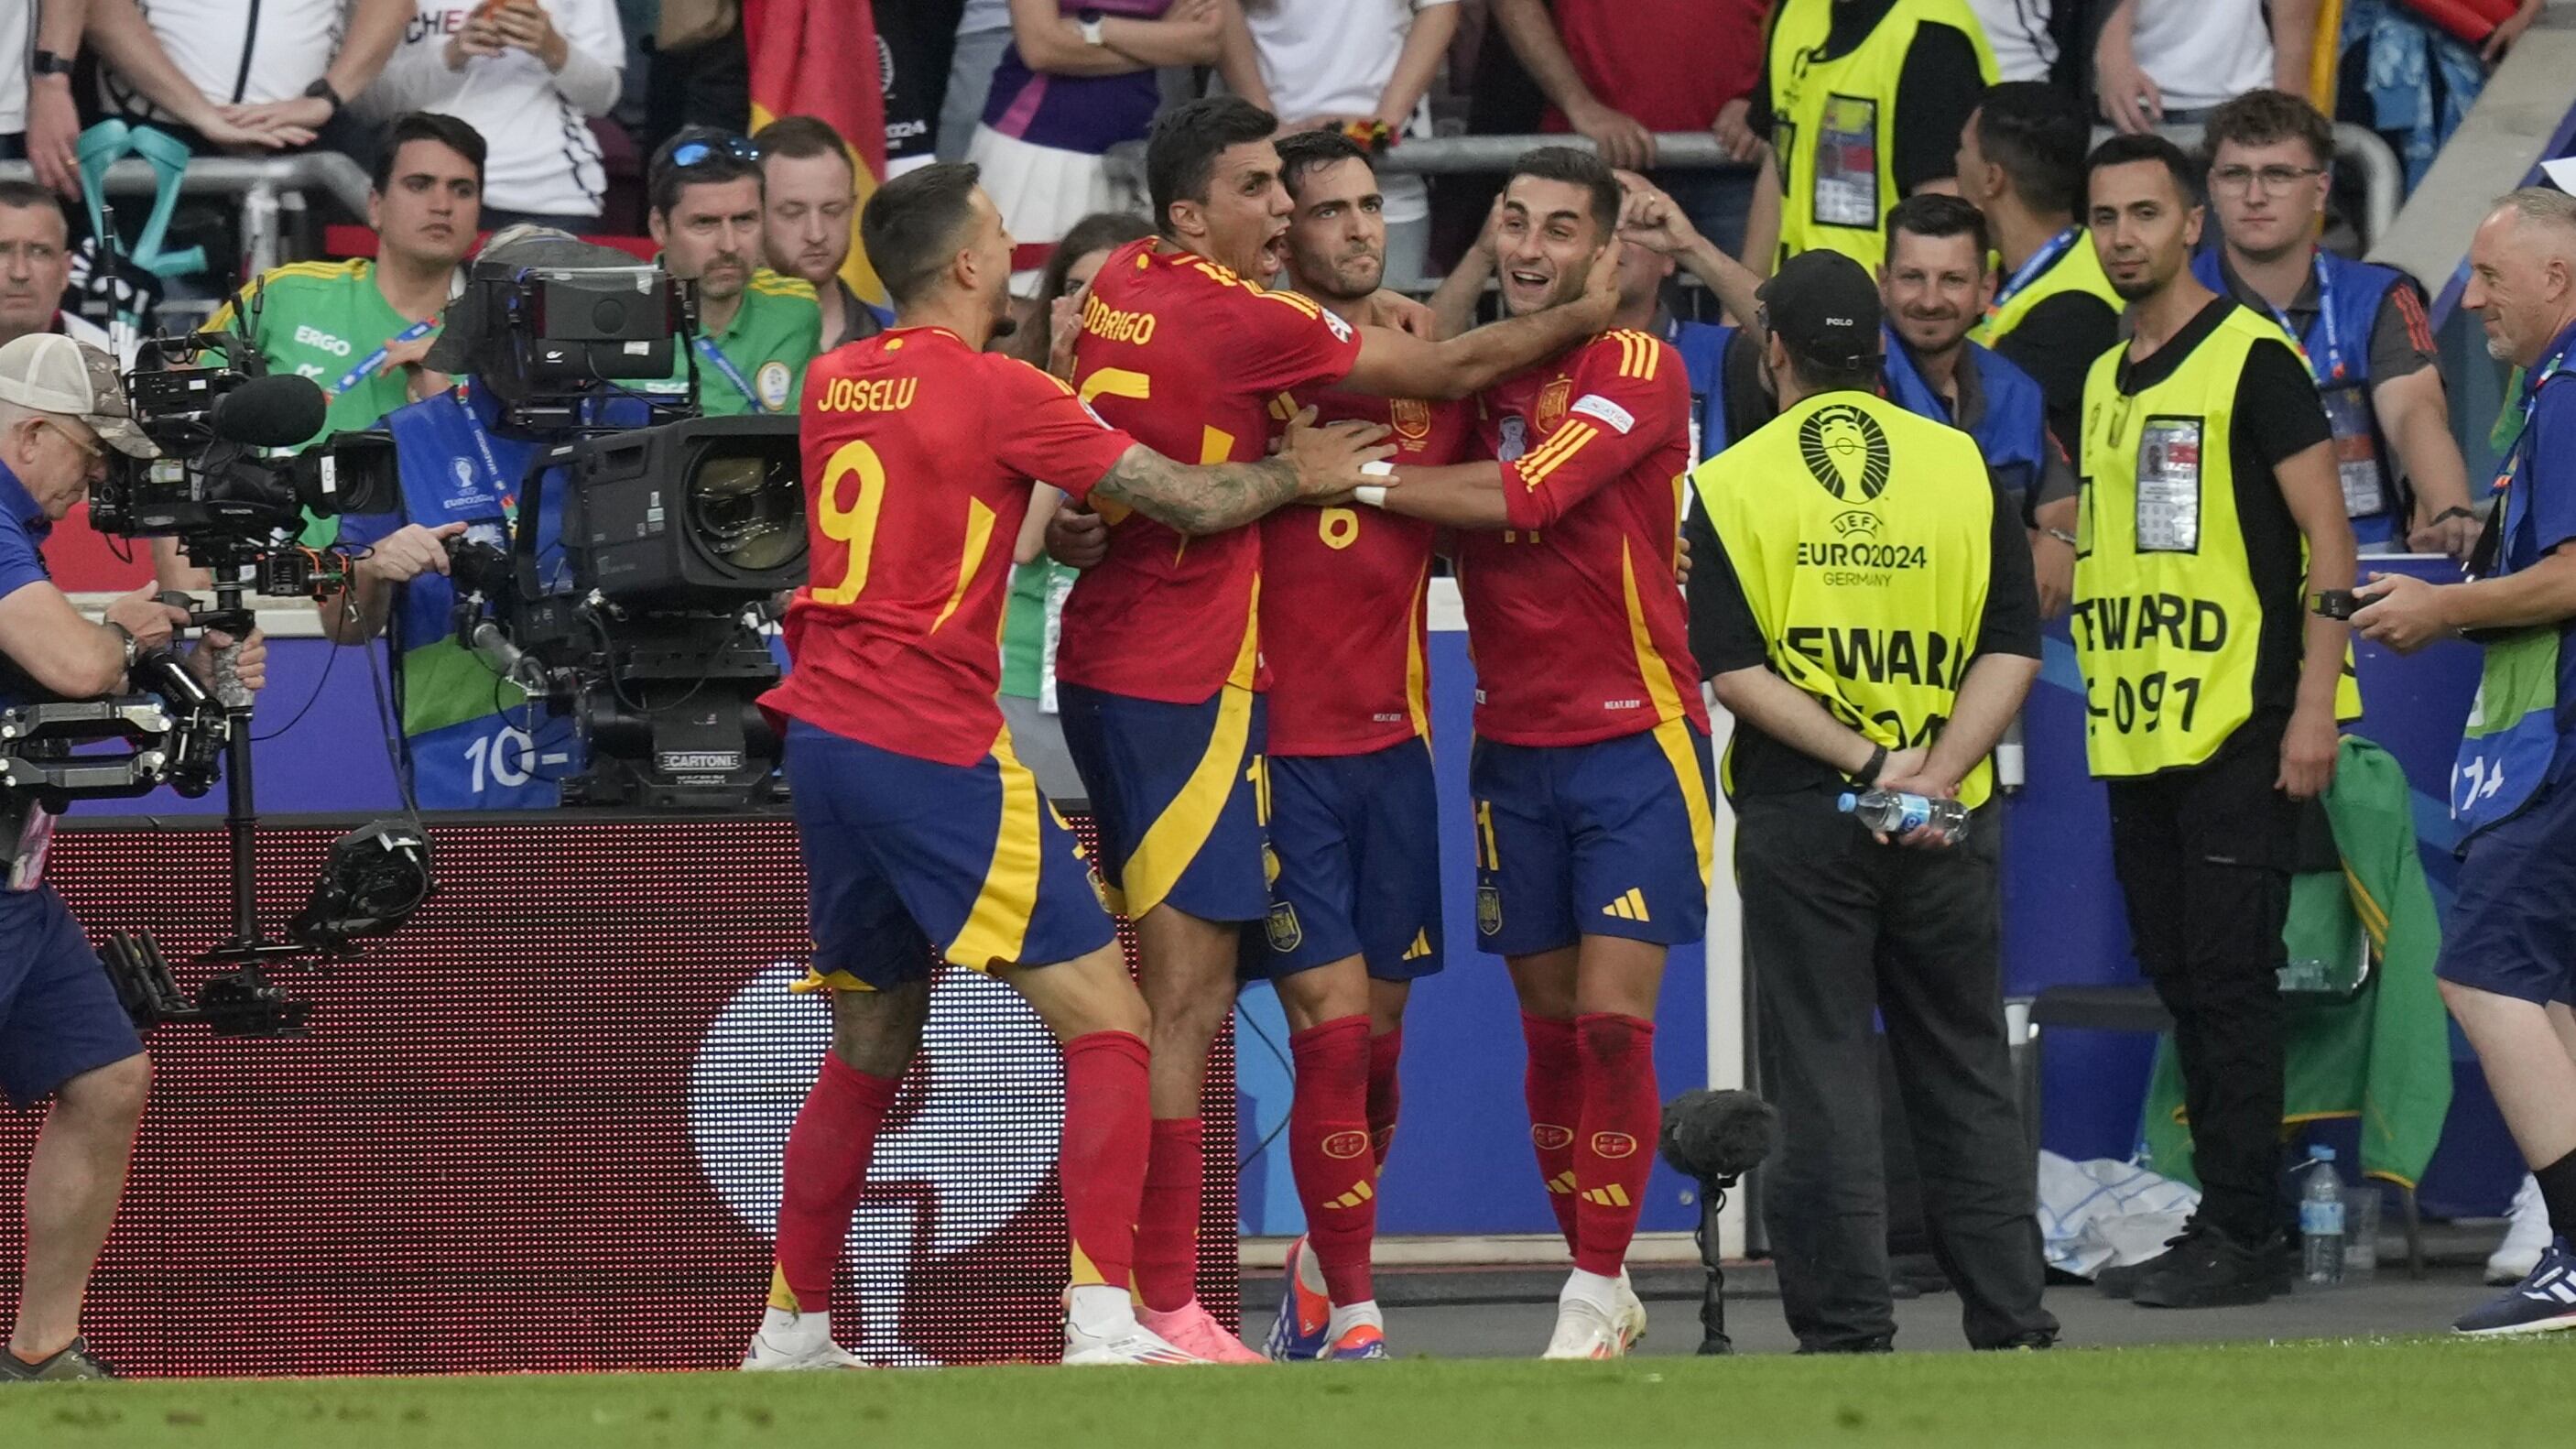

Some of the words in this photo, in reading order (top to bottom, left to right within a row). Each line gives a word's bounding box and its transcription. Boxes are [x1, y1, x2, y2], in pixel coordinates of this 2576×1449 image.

[1082, 294, 1156, 345] ODRIGO
[1825, 317, 1853, 326] POLO
[294, 325, 352, 357] ERGO
[818, 376, 918, 412] JOSELU
[811, 439, 886, 605] 9
[1797, 542, 1927, 569] EURO2024
[1823, 572, 1893, 588] GERMANY
[669, 755, 733, 768] CARTONI
